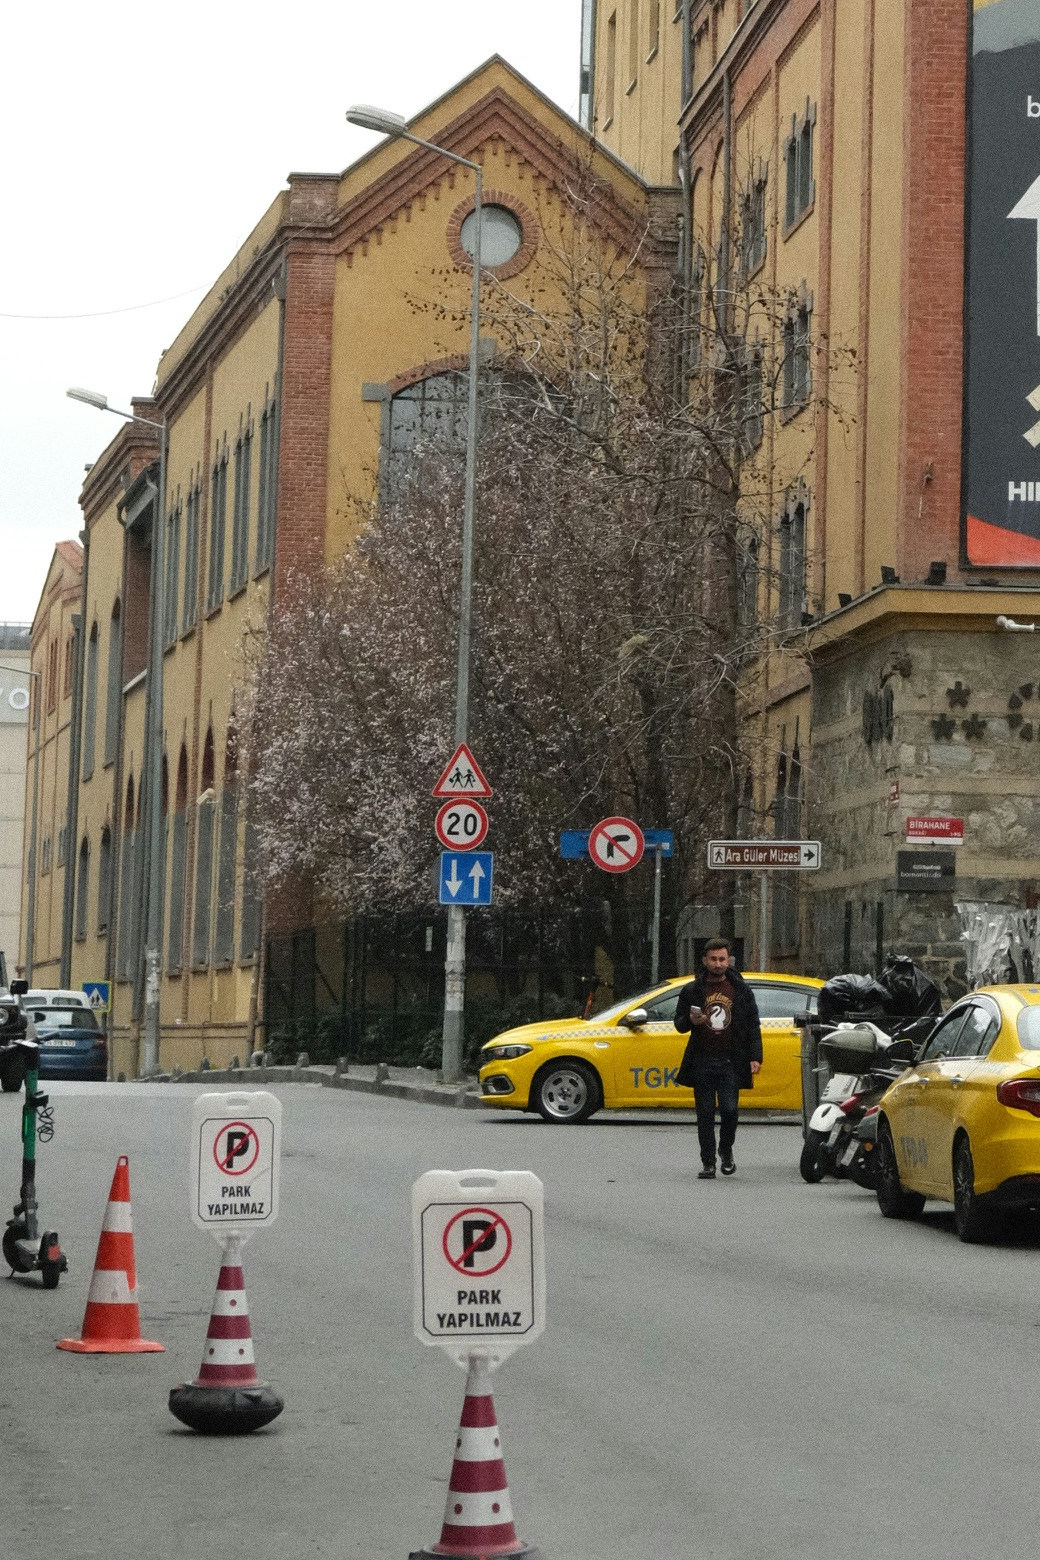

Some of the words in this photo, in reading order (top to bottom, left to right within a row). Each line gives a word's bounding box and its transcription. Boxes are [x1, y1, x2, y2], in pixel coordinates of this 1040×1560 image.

[446, 812, 478, 836] 20
[909, 820, 951, 830] BİRAHANE
[725, 848, 741, 863] Ara
[743, 848, 767, 863] Güler
[769, 848, 801, 863] Müzesi
[221, 1185, 251, 1198] PARK
[207, 1202, 264, 1216] YAPILMAZ
[457, 1290, 501, 1305] PARK
[436, 1312, 522, 1328] YAPILMAZ
